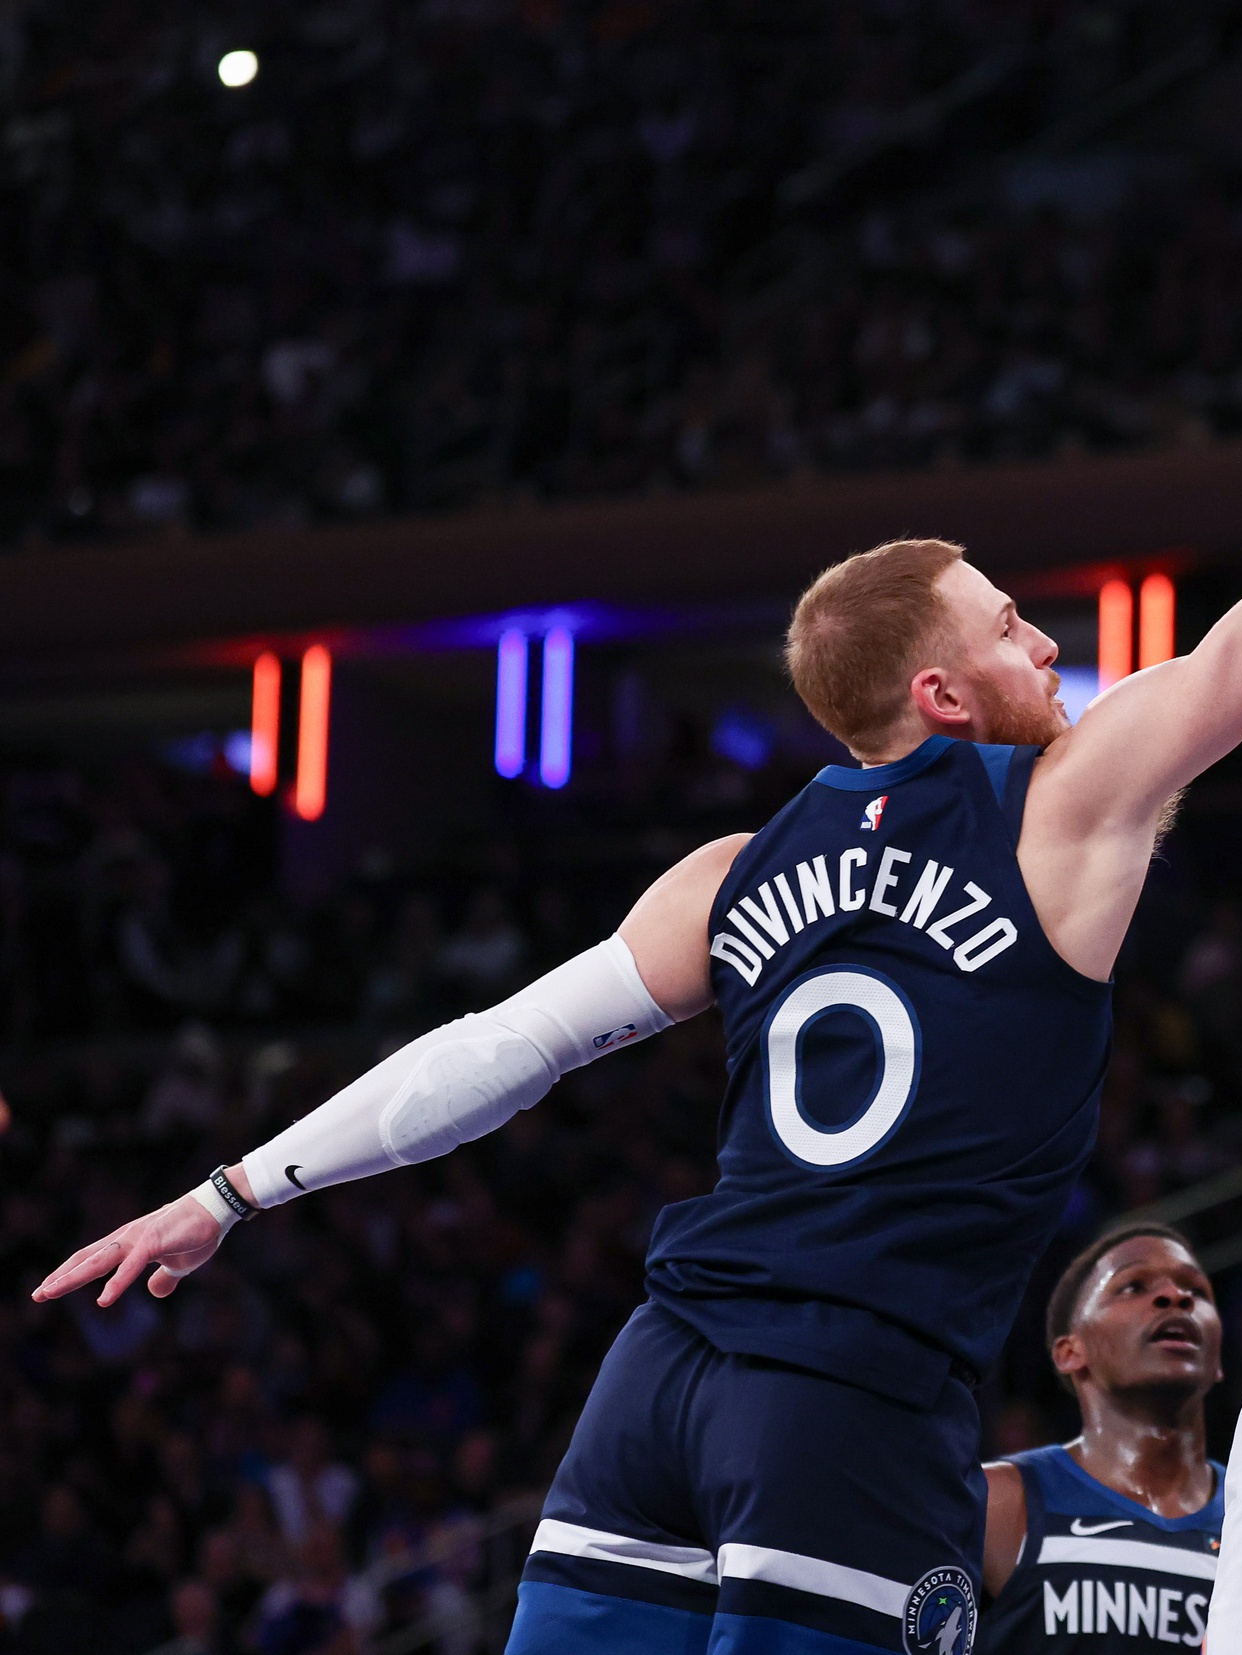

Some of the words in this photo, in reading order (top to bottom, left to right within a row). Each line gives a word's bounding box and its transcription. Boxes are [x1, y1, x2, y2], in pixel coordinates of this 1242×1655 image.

[710, 846, 1018, 987] DIVINCENZO
[763, 966, 920, 1170] 0
[214, 1175, 247, 1214] Blessed
[907, 1573, 952, 1635] MINNESOTA
[1043, 1579, 1208, 1648] MINNES
